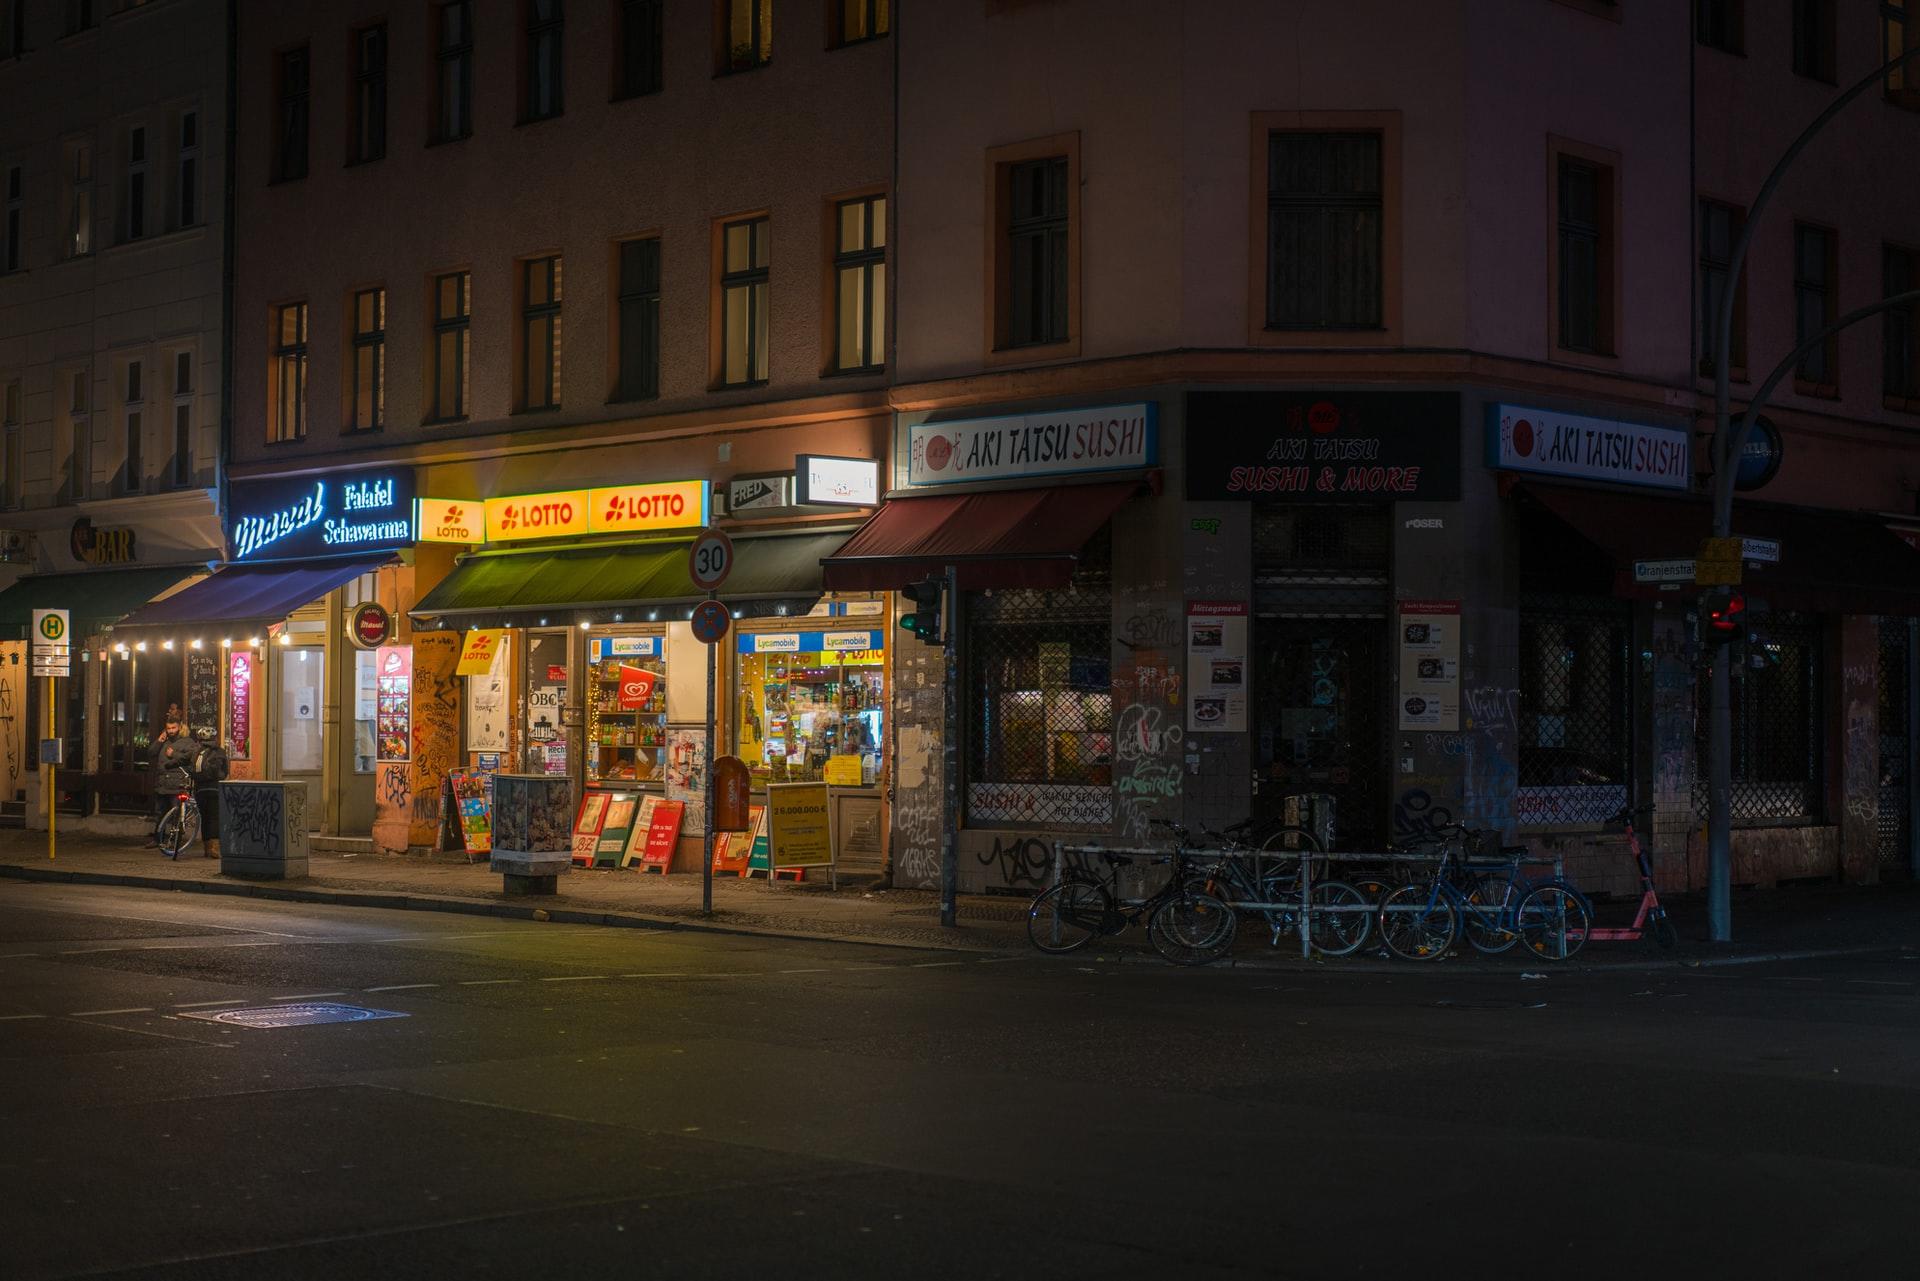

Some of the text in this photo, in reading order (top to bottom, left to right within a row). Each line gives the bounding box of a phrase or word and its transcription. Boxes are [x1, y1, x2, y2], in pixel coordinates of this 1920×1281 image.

[967, 417, 1145, 469] AKI TATSU SUSHI
[1267, 438, 1380, 461] AKI TATSU
[1550, 426, 1686, 478] AKI TATSU SUSHI
[733, 480, 762, 503] FRED
[1226, 466, 1421, 493] SUSHI & MORE
[343, 479, 393, 510] Falafel
[629, 494, 684, 519] LOTTO
[522, 503, 572, 527] LOTTO
[323, 518, 409, 545] Schawarma
[436, 526, 469, 539] LOTTO
[96, 527, 136, 563] BAR
[698, 545, 723, 575] 30
[47, 620, 58, 635] H
[757, 637, 796, 650] Lycamobile
[827, 636, 867, 647] Lycamobile
